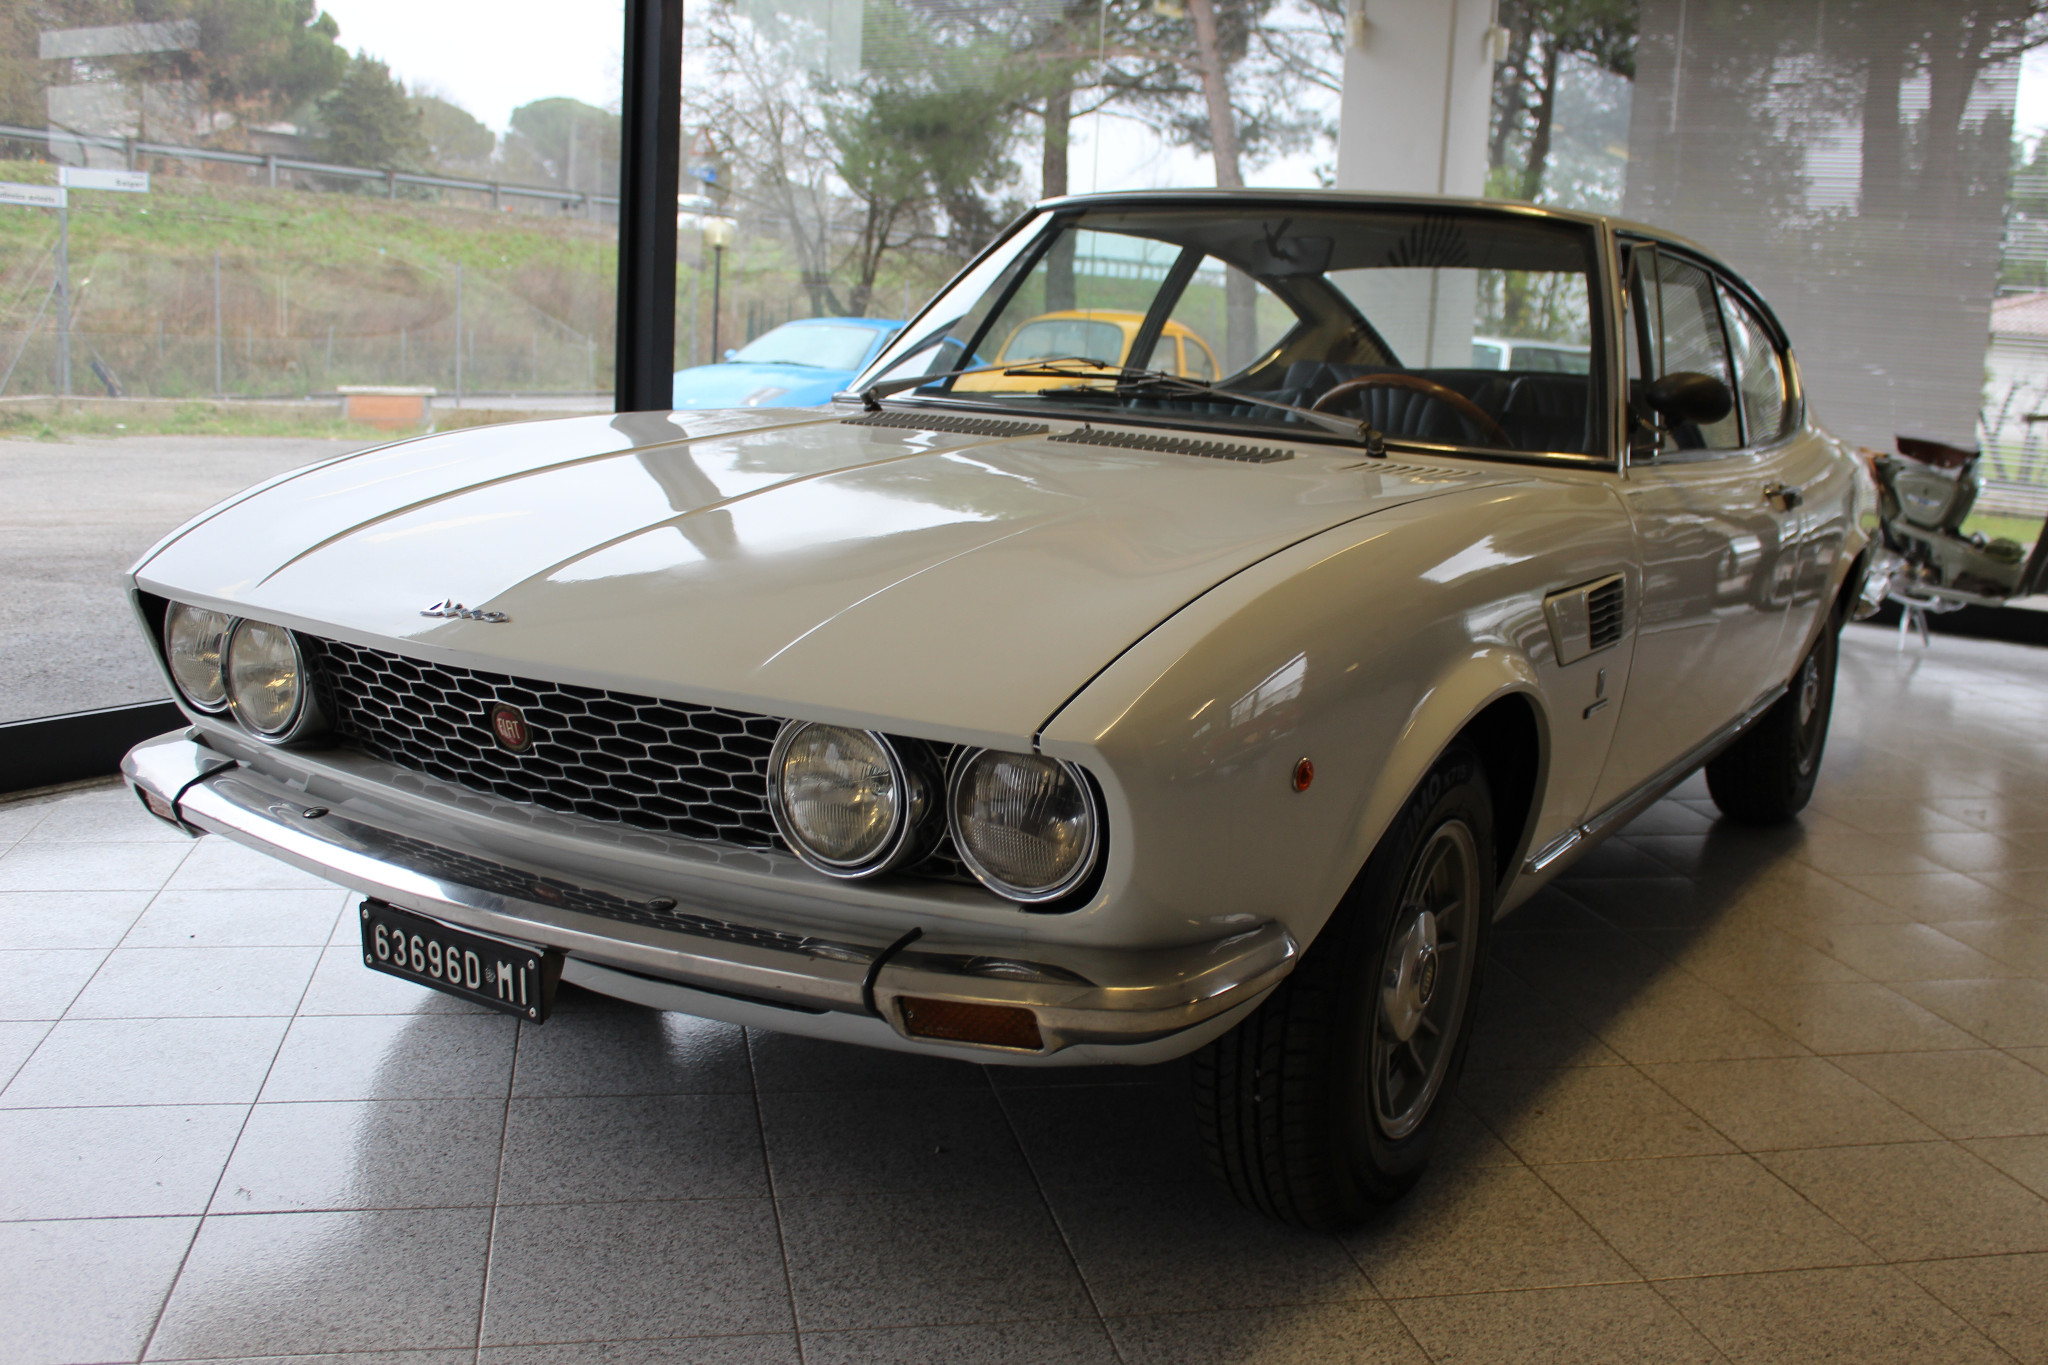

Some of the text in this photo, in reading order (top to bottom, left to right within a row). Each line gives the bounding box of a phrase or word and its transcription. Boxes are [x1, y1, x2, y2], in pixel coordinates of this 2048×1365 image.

[497, 717, 519, 740] FIAT
[374, 923, 528, 1006] 63696D MI
